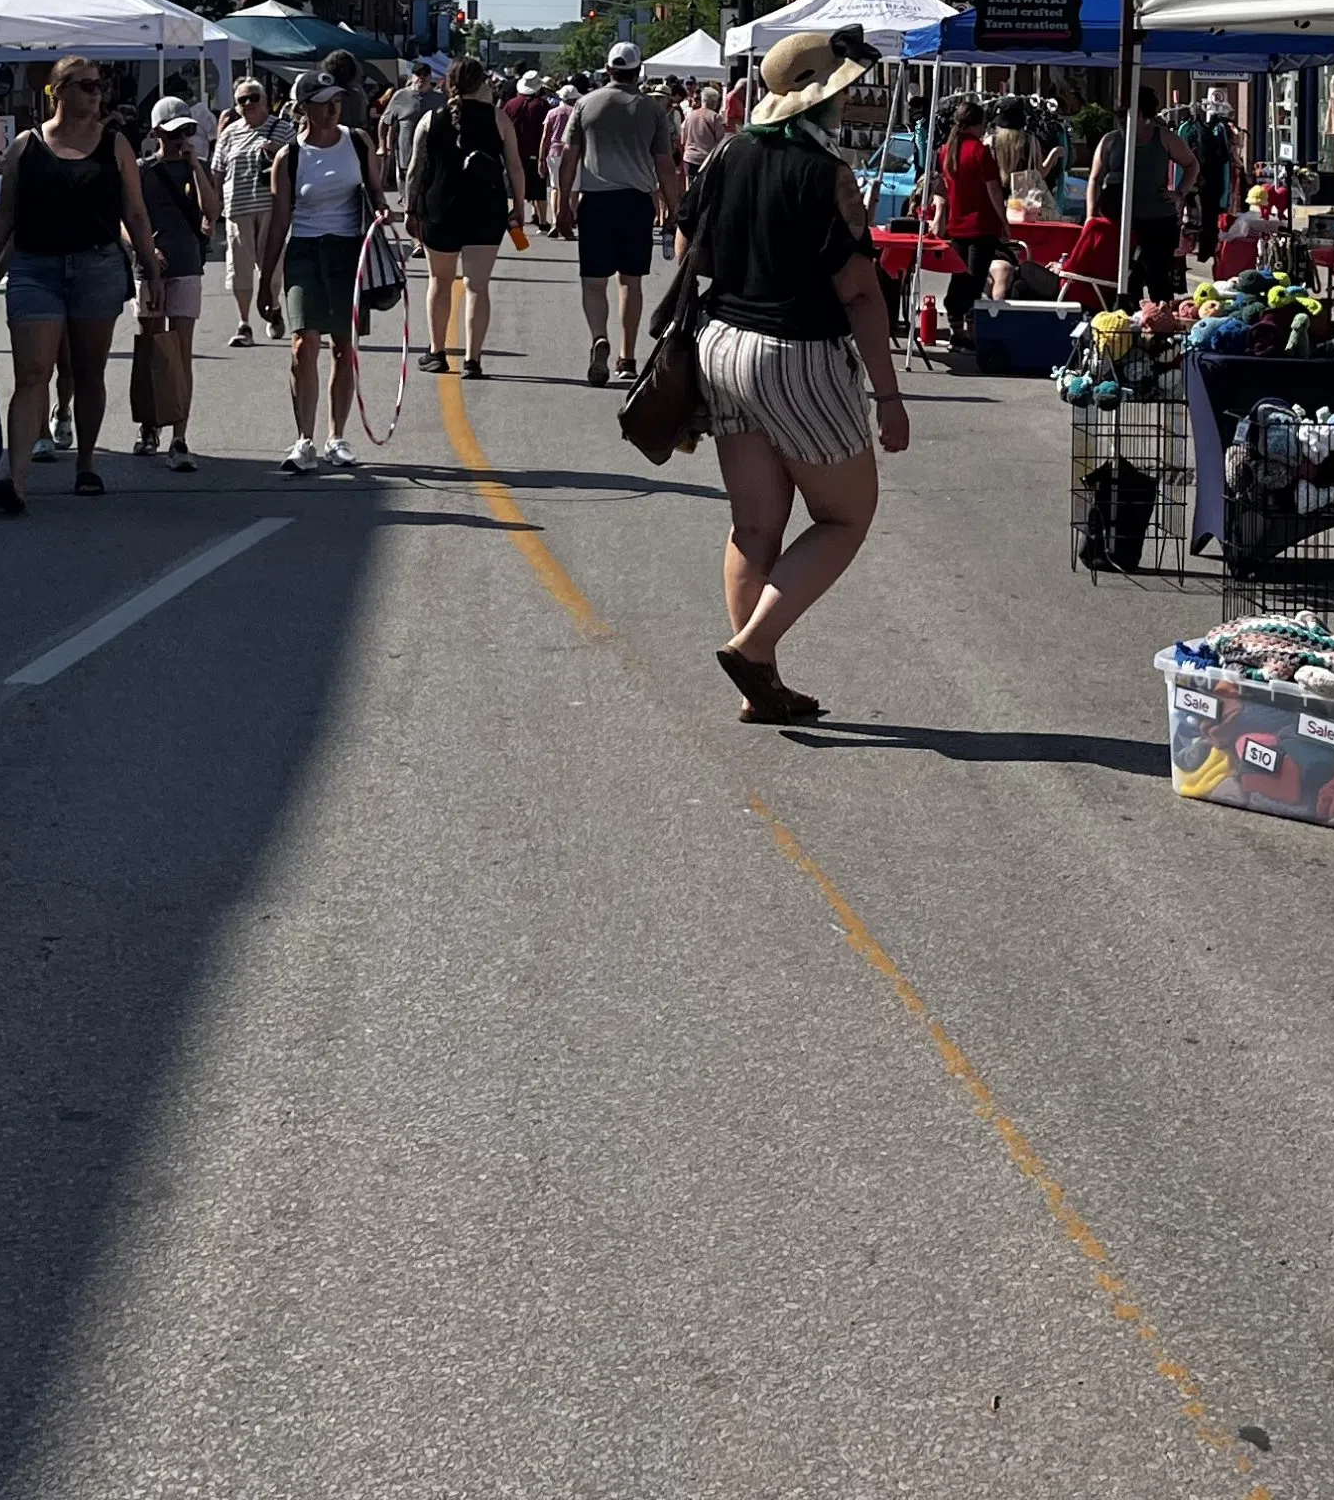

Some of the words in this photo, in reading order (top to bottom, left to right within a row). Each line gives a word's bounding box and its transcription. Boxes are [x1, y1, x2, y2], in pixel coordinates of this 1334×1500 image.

[885, 2, 922, 12] BEACH
[986, 7, 1018, 16] Hand
[1020, 7, 1063, 17] crafted
[985, 19, 1012, 29] Yarn
[1014, 20, 1069, 30] creations
[1183, 693, 1210, 713] Sale
[1249, 747, 1272, 767] $10
